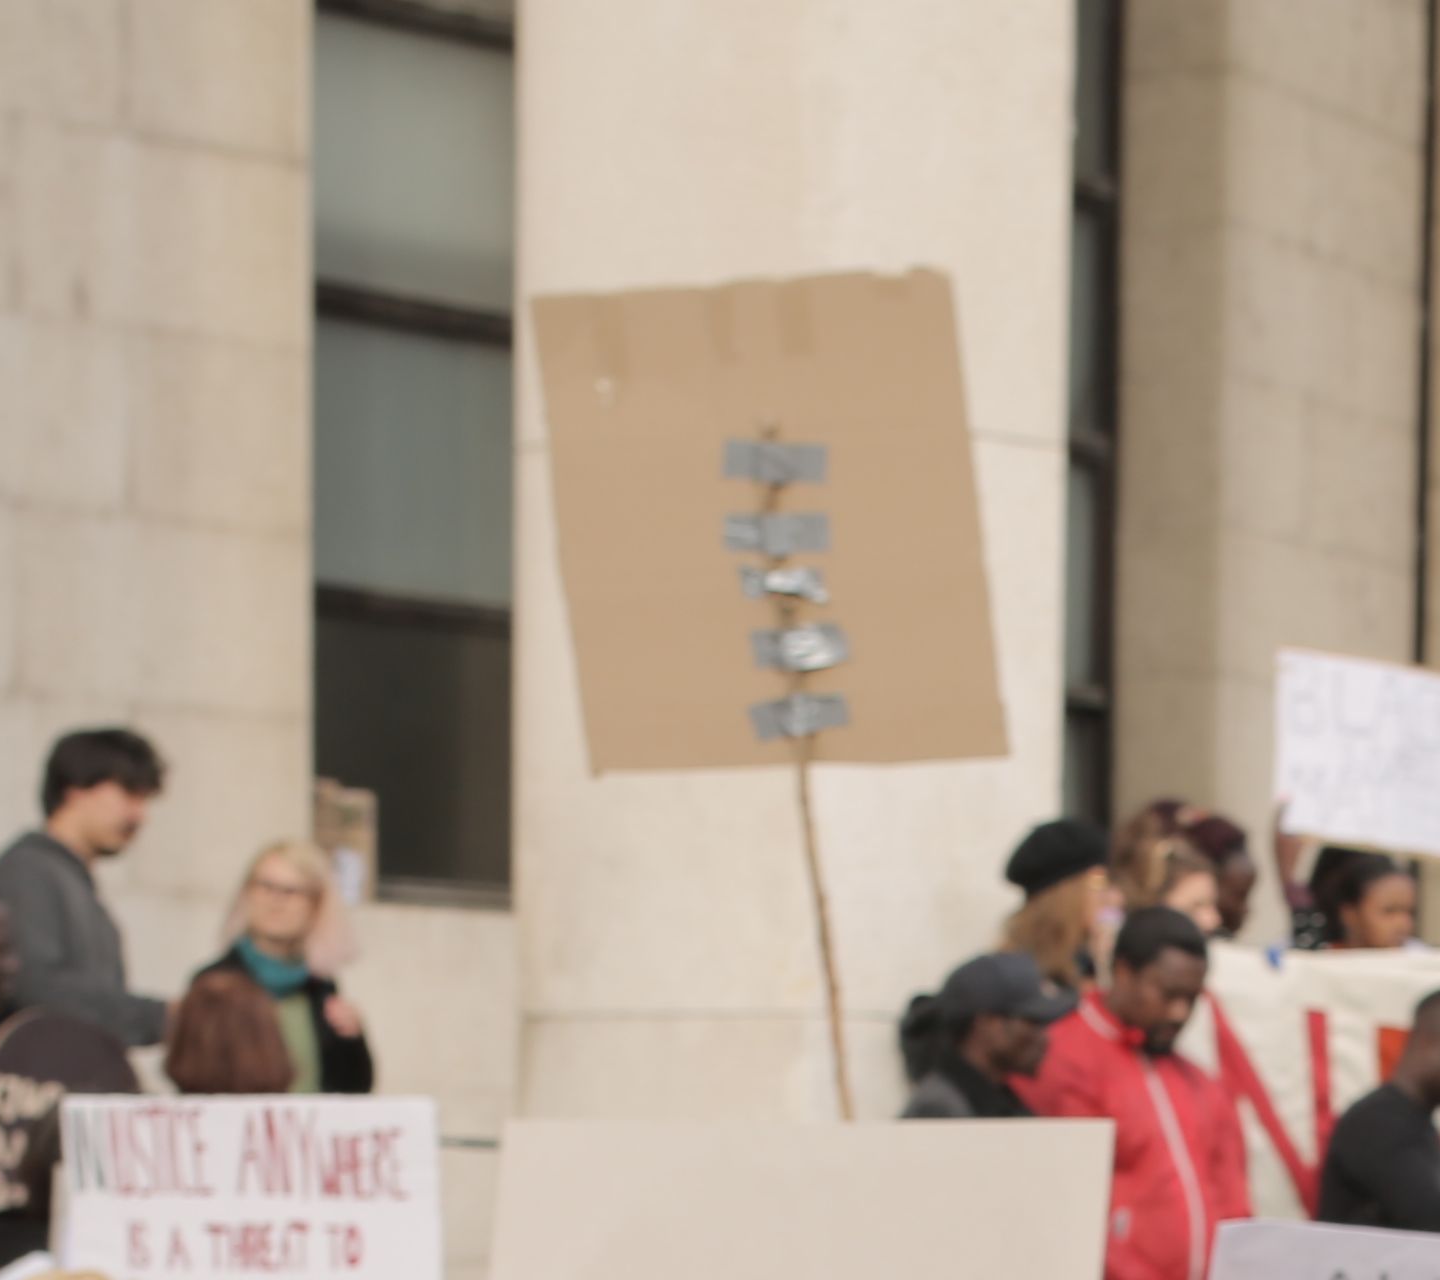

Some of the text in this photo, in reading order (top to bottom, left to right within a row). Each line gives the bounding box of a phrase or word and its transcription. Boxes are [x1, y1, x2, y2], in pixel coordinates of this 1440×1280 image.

[127, 1220, 364, 1272] IS A THREAT TO
